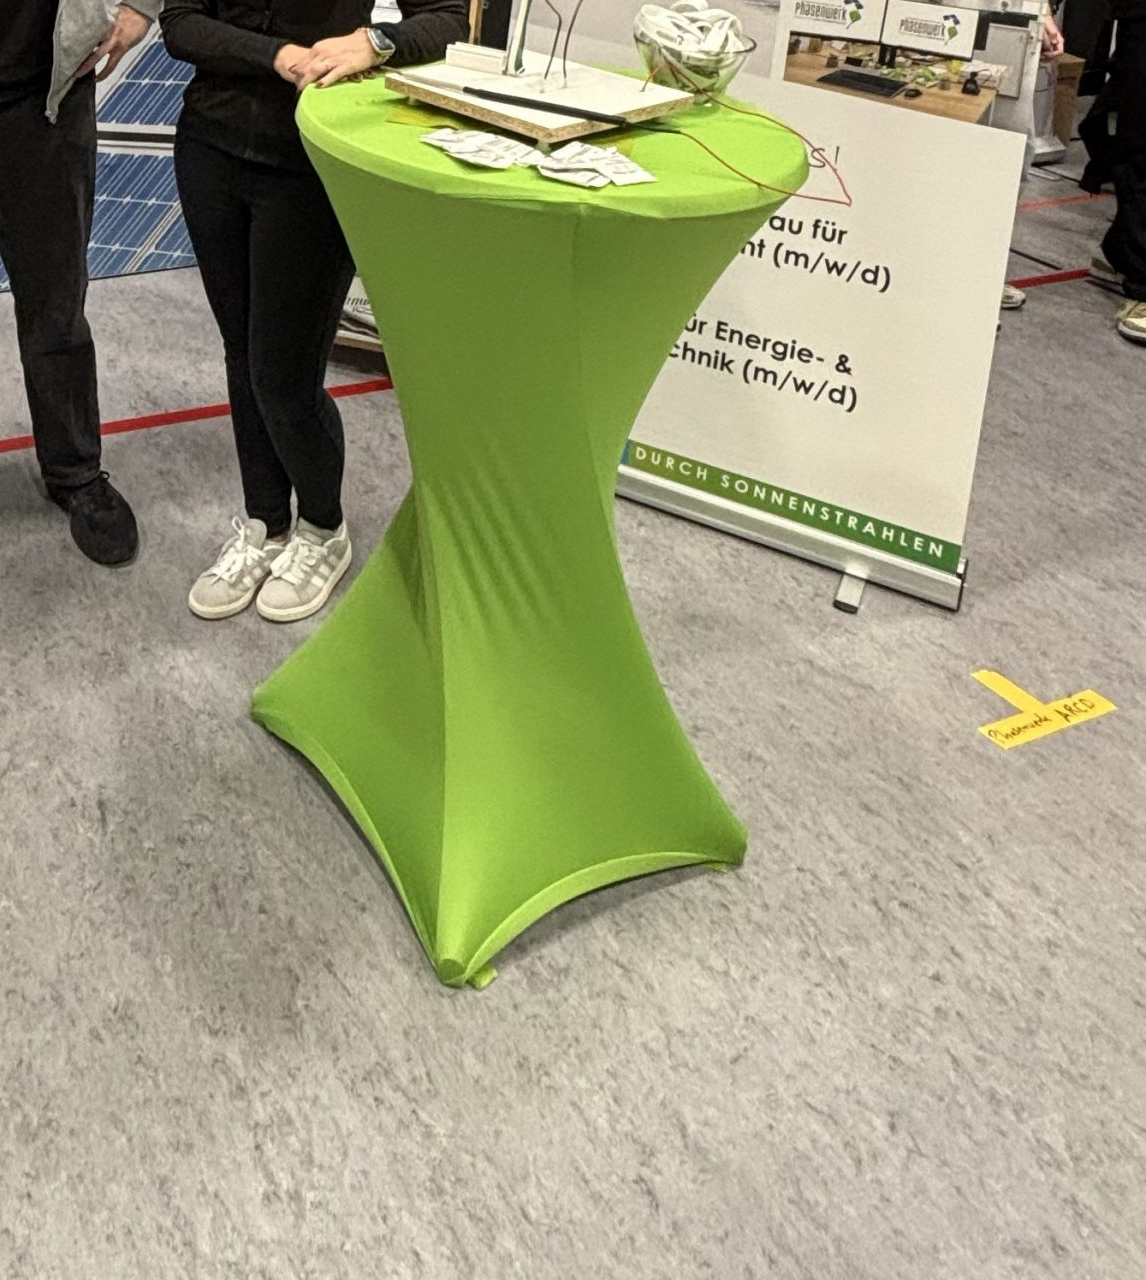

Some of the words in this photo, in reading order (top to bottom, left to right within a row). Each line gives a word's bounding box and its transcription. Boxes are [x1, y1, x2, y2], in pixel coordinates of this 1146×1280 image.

[812, 218, 848, 245] für
[773, 242, 891, 293] (m/w/d)
[715, 320, 825, 364] Energie-
[835, 354, 853, 376] &
[742, 358, 858, 413] (m/w/d)
[635, 446, 707, 481] DURCH
[721, 474, 943, 558] SONNENSTRAHLEN
